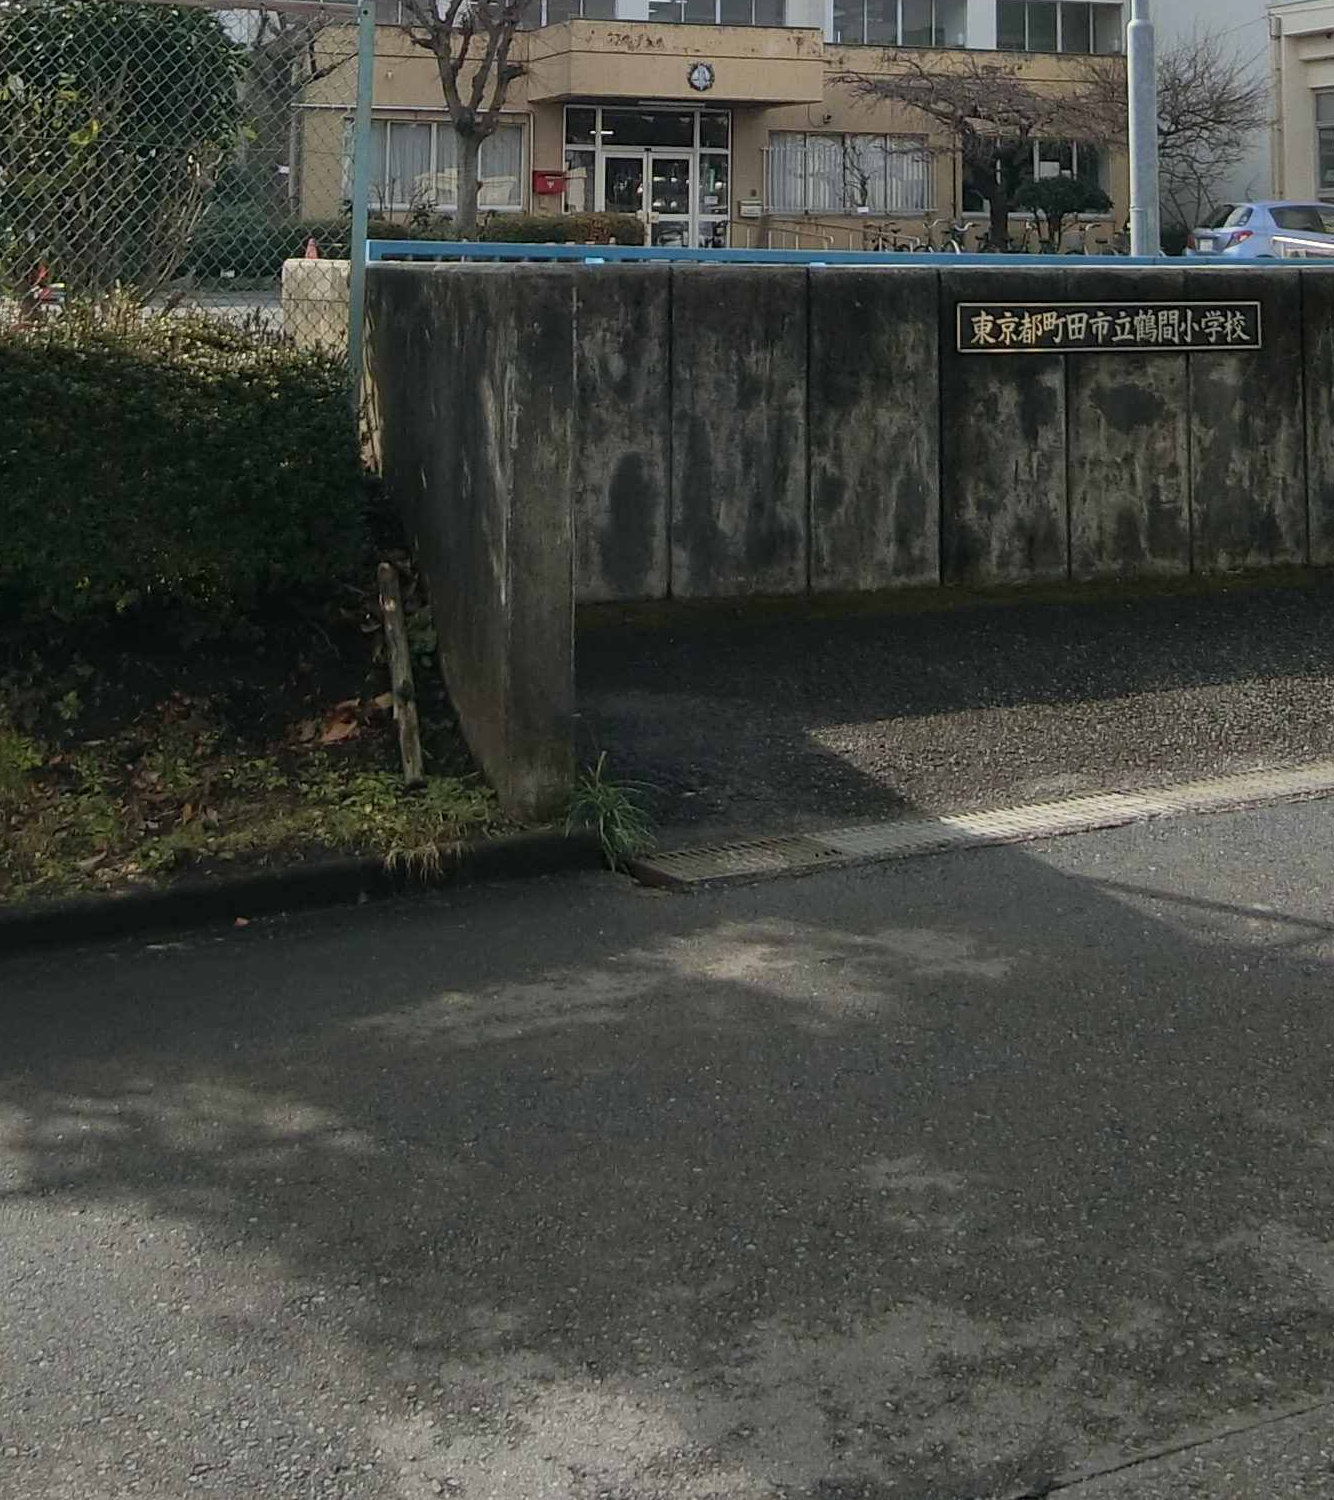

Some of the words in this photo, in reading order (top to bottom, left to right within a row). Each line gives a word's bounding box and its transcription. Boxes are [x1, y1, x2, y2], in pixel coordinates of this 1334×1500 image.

[969, 308, 1251, 347] 東京都町田市立鶴間小学校
